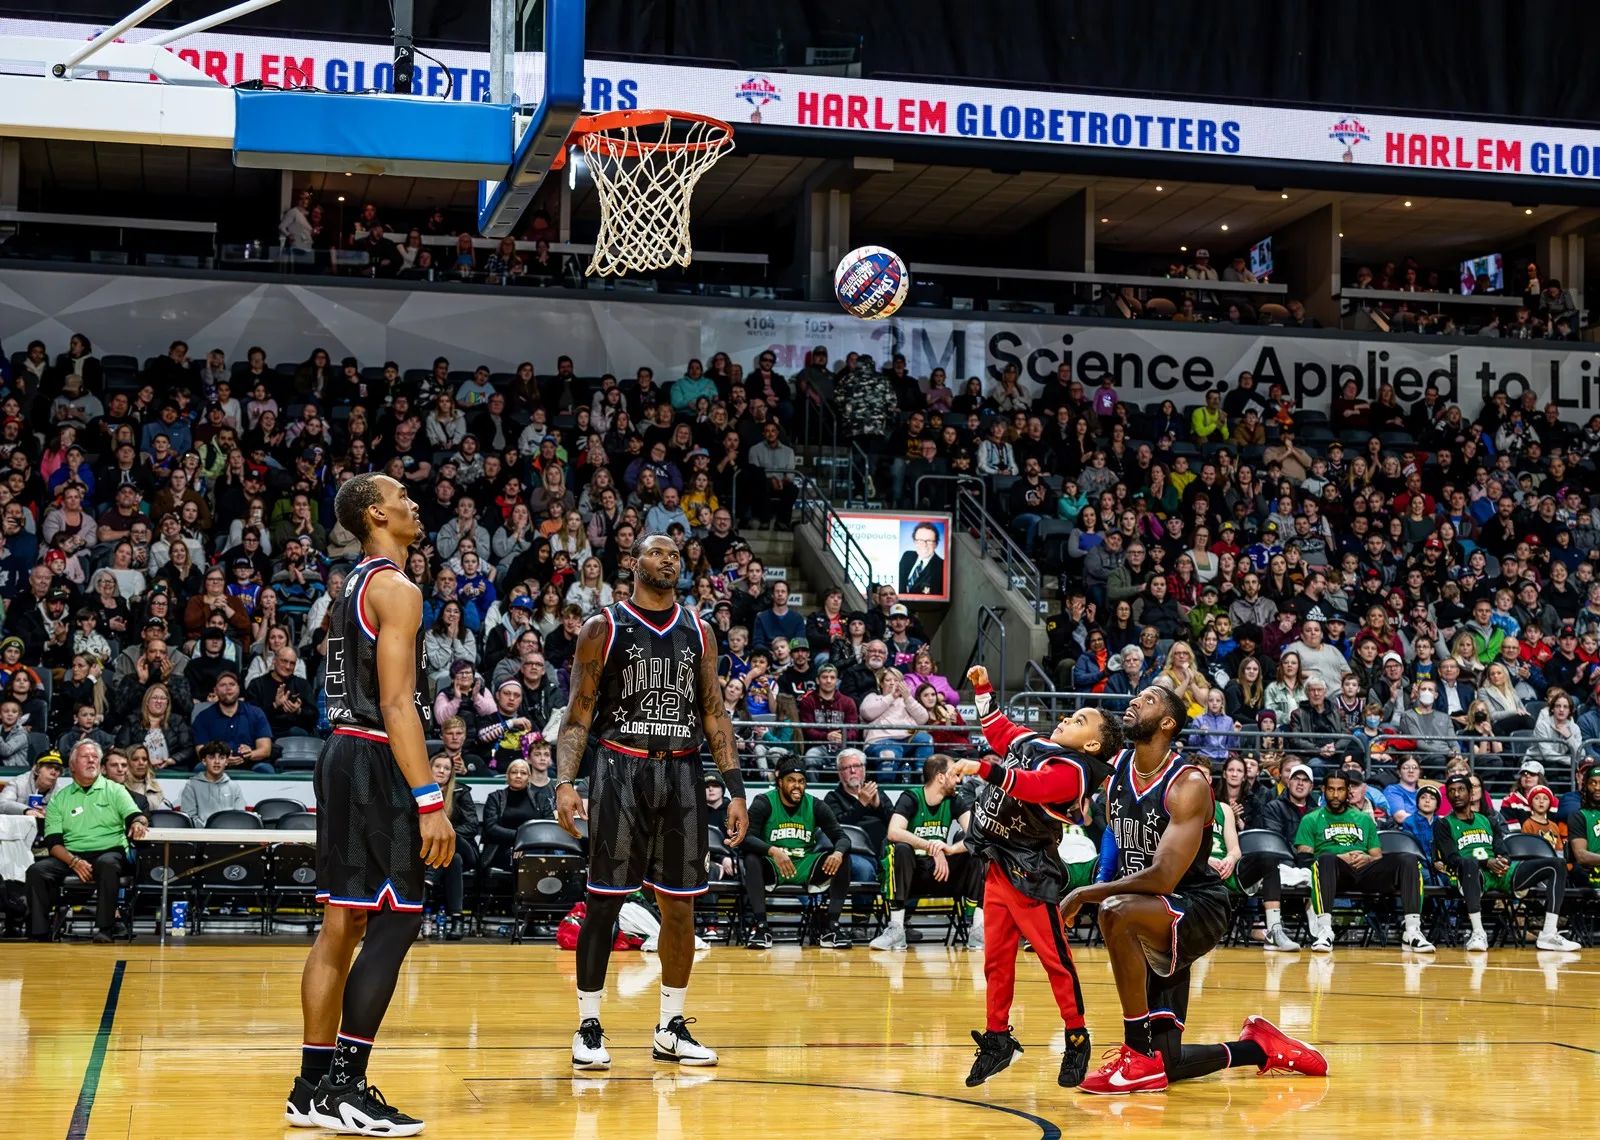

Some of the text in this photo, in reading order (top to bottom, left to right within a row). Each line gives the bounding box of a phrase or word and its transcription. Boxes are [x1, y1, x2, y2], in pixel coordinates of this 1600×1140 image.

[798, 91, 1240, 153] HARLEM GLOBETROTTERS
[1385, 132, 1522, 172] HARLEM
[846, 268, 875, 299] HARLEM
[854, 274, 894, 315] SPALDING
[752, 317, 775, 330] 104
[805, 318, 828, 332] 105
[987, 331, 1229, 393] Science.
[1252, 346, 1458, 410] Applied
[1476, 361, 1531, 402] to
[640, 690, 681, 722] 42
[620, 721, 691, 738] GLOBETROTTERS
[770, 828, 812, 843] GENERALS
[1110, 817, 1161, 856] ARLE
[1324, 827, 1364, 841] GENERALS
[298, 869, 307, 883] 9
